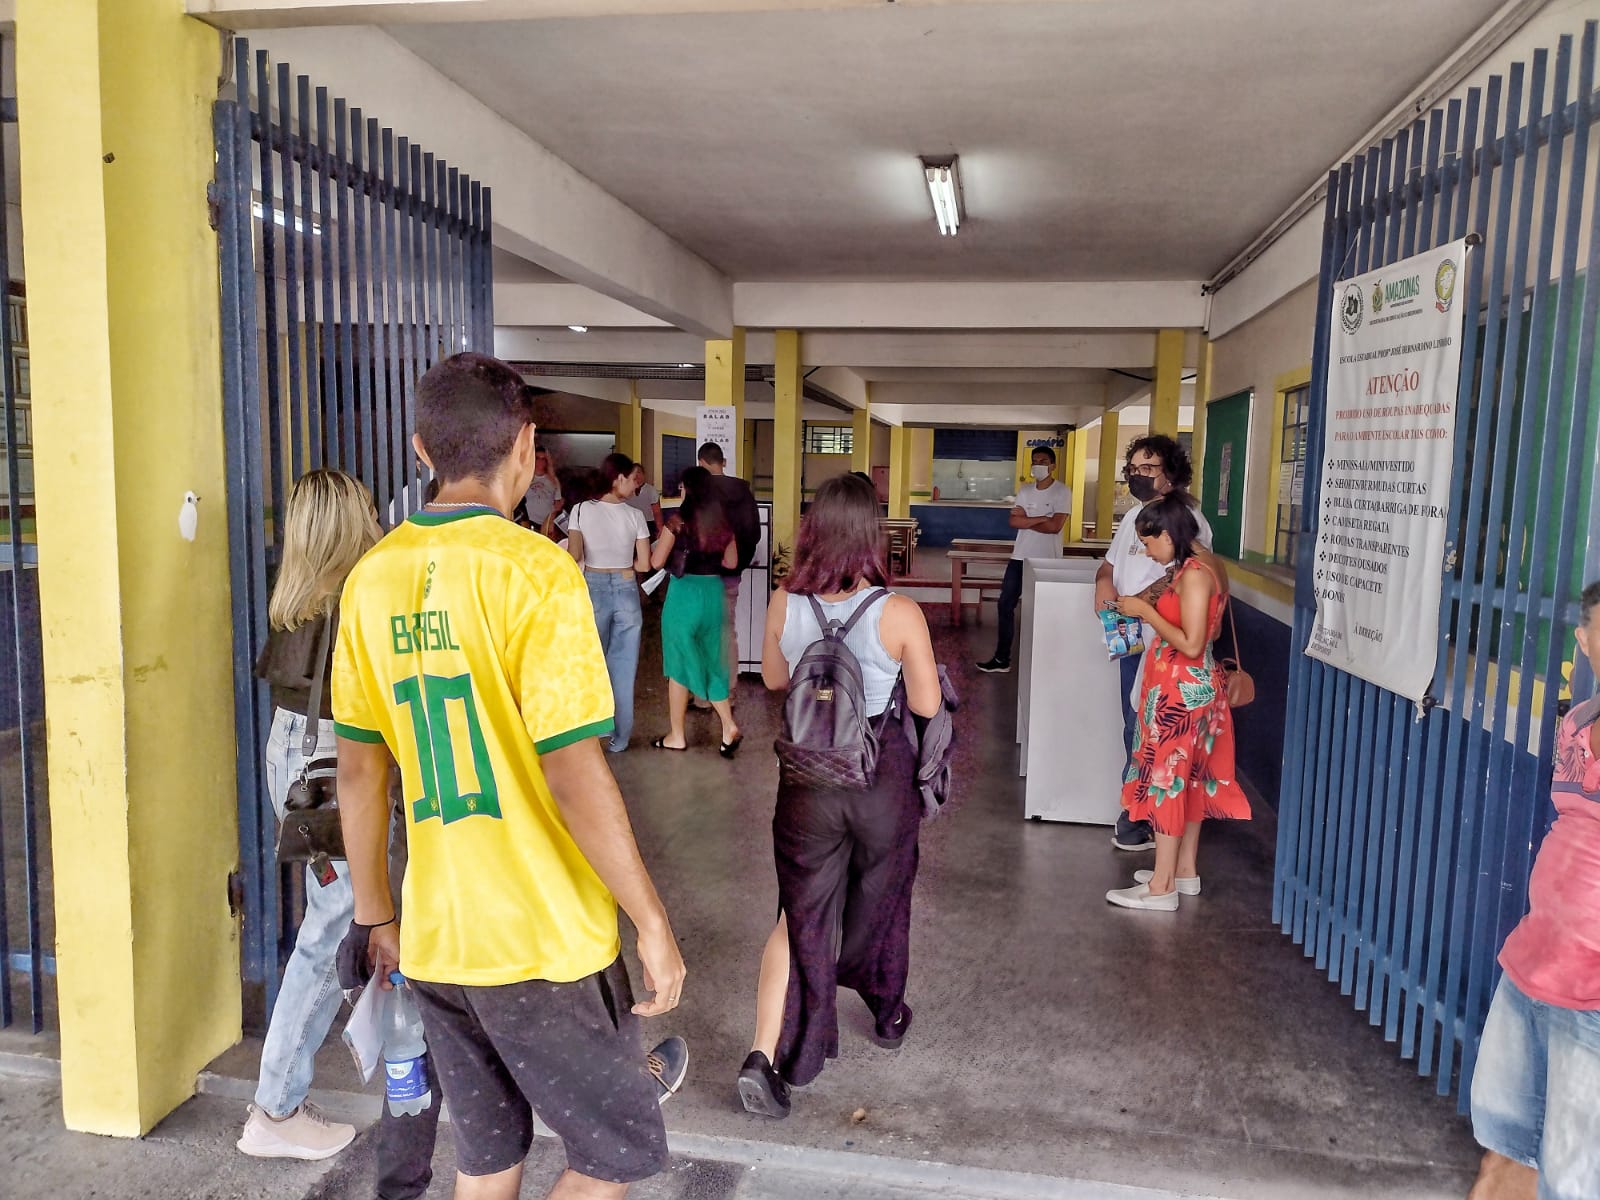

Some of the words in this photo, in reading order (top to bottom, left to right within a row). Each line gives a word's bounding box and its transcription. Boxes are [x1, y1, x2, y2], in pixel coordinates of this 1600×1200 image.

[1385, 275, 1420, 303] AMAZONAS
[1366, 368, 1420, 397] ATENÇÃO
[1397, 482, 1427, 495] CURTAS
[1408, 504, 1419, 515] DE
[1364, 520, 1390, 534] REGATA
[1356, 538, 1410, 558] TRANSPARENTES
[1328, 552, 1357, 567] DECOTES
[1358, 558, 1388, 575] OUSADOS
[1326, 570, 1341, 582] USO
[1350, 576, 1383, 594] CAPACETE
[391, 611, 460, 655] BRASIL
[393, 672, 503, 825] 10
